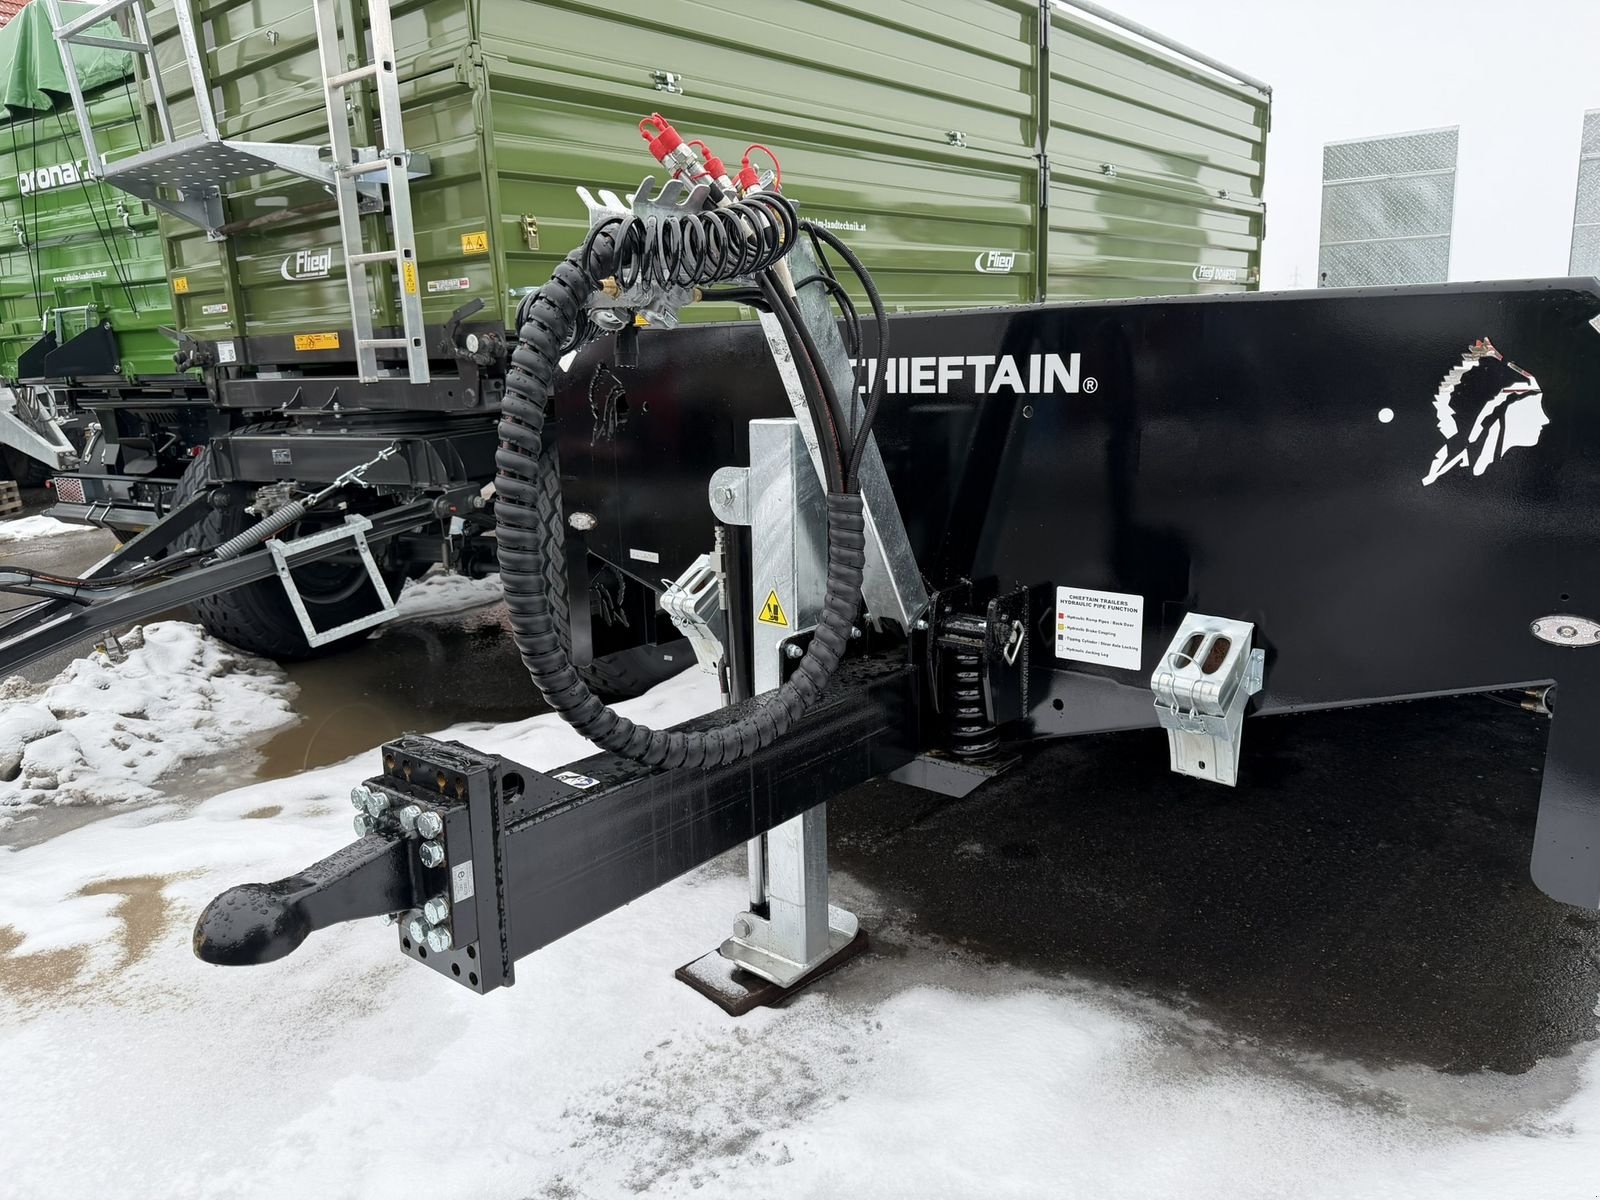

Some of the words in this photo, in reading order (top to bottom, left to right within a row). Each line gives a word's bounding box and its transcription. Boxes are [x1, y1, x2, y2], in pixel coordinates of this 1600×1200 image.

[296, 248, 331, 276] Fliegl
[987, 251, 1015, 271] Fliegl
[1060, 599, 1092, 608] HYDRAULIC
[1069, 594, 1098, 603] CHIEFTAIN
[1100, 598, 1128, 606] TRAILERS
